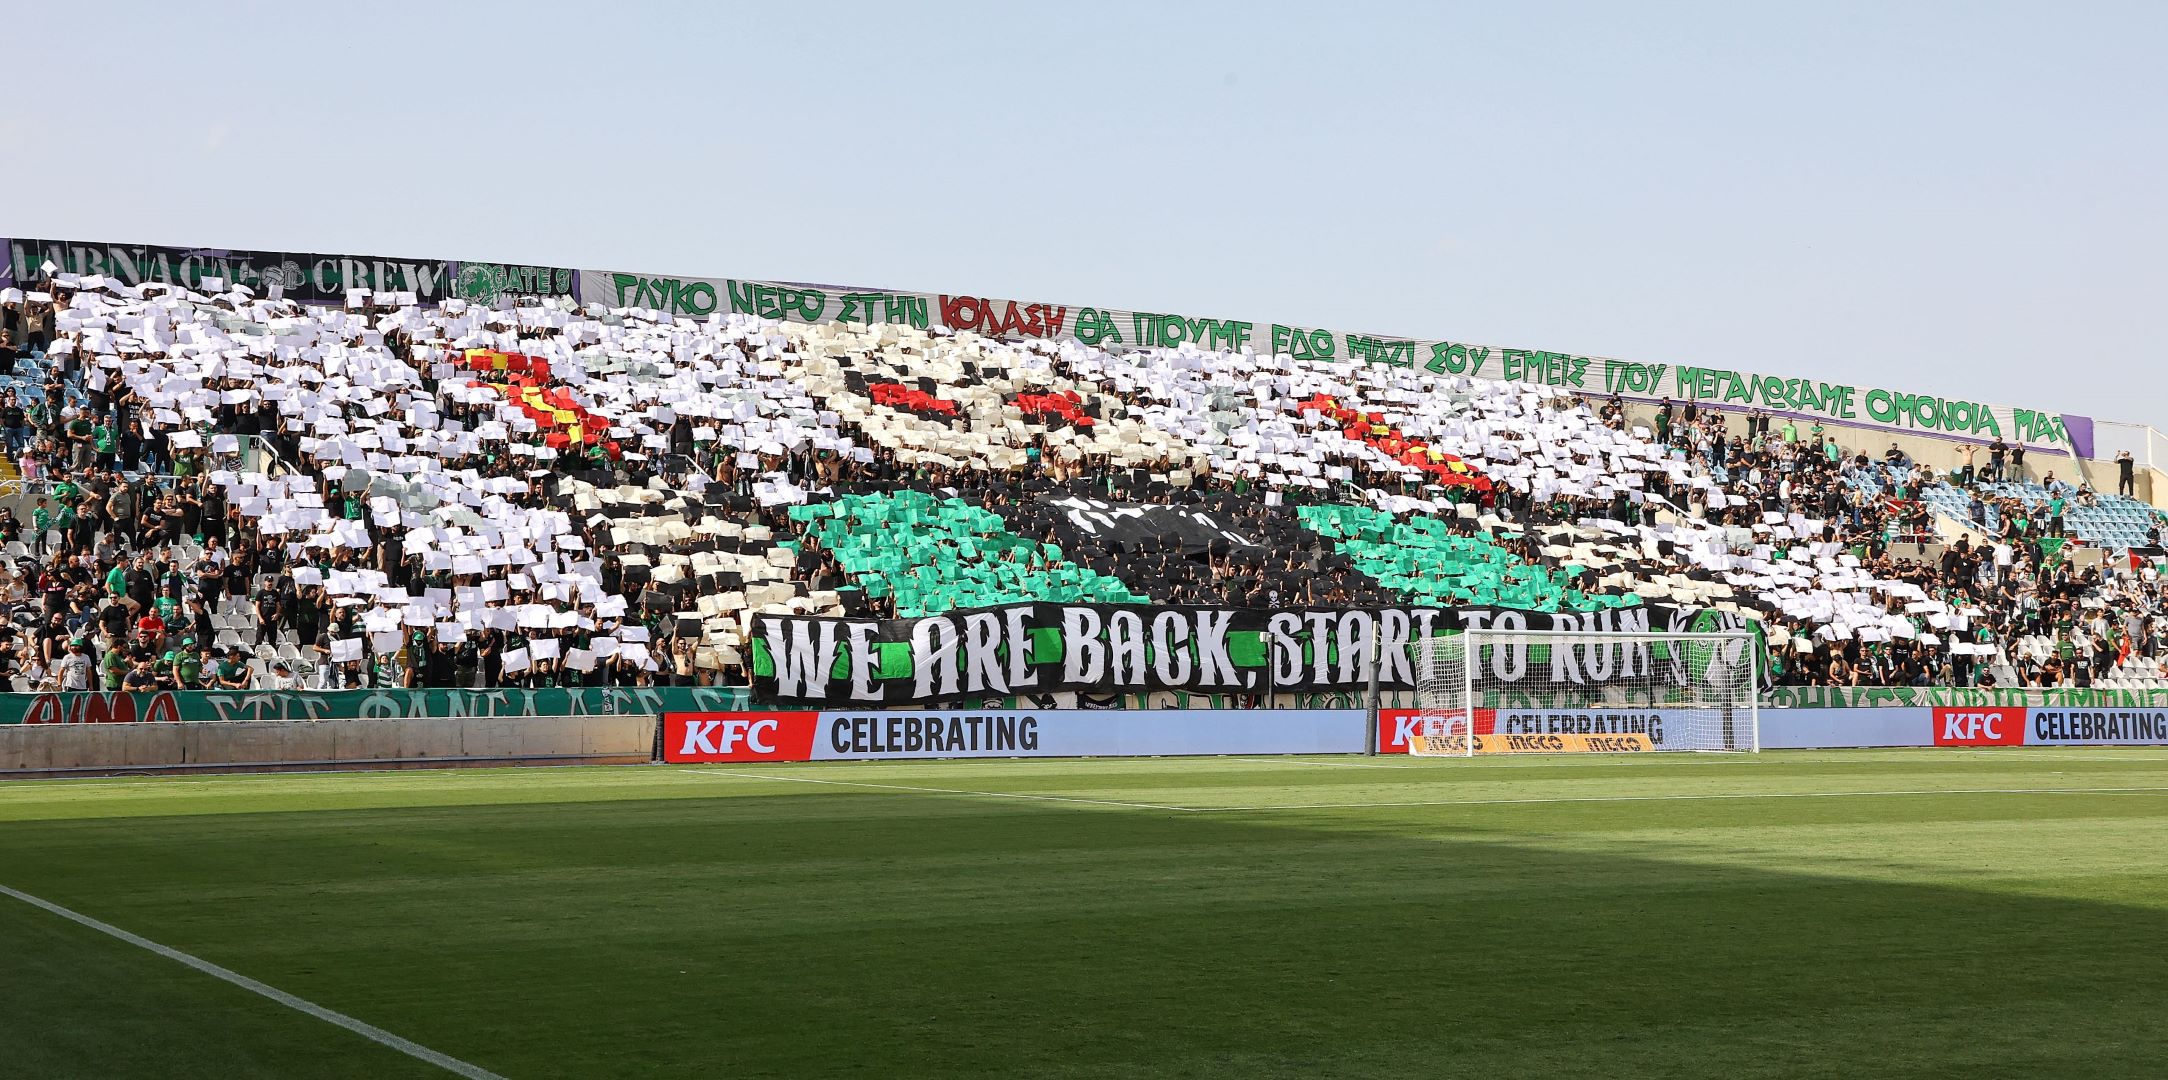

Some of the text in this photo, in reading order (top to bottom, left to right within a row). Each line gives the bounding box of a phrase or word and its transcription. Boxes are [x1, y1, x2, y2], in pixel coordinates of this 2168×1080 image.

[313, 258, 447, 297] CREW
[491, 265, 571, 293] GATE 9
[612, 273, 716, 316] ΓΛΥΚΟ
[727, 280, 826, 322] ΝΕΡΟ
[836, 292, 929, 330] ΣΤΗΝ
[939, 294, 1066, 338] ΚΟΛΑΣΗ
[1074, 307, 1122, 345] ΘΑ
[1133, 312, 1252, 350] ΠΙΟΥΜΕ
[1271, 323, 1335, 362] ΕΔΩ
[1346, 335, 1415, 368] ΜΑΖΙ
[1425, 341, 1490, 376] ΣΟΥ
[1502, 349, 1591, 388] ΕΜΕΙΣ
[1605, 360, 1666, 393] ΠΟΥ
[1676, 365, 1856, 418] ΜΕΓΑΛΩΣΑΜΕ
[1866, 389, 2001, 437] ΟΜΟΝΟΙΑ
[764, 618, 884, 700] WE
[911, 606, 1039, 699] ARE
[1268, 609, 1440, 687] START
[1459, 610, 1527, 682] TO
[1550, 608, 1652, 685] RUN
[679, 719, 778, 755] KFC
[832, 717, 1038, 752] CELEBRATING
[1391, 716, 1468, 746] KFC
[1506, 714, 1663, 745] CELEBRATING
[1942, 713, 2003, 740] KFC
[2035, 712, 2167, 740] CELEBRATING
